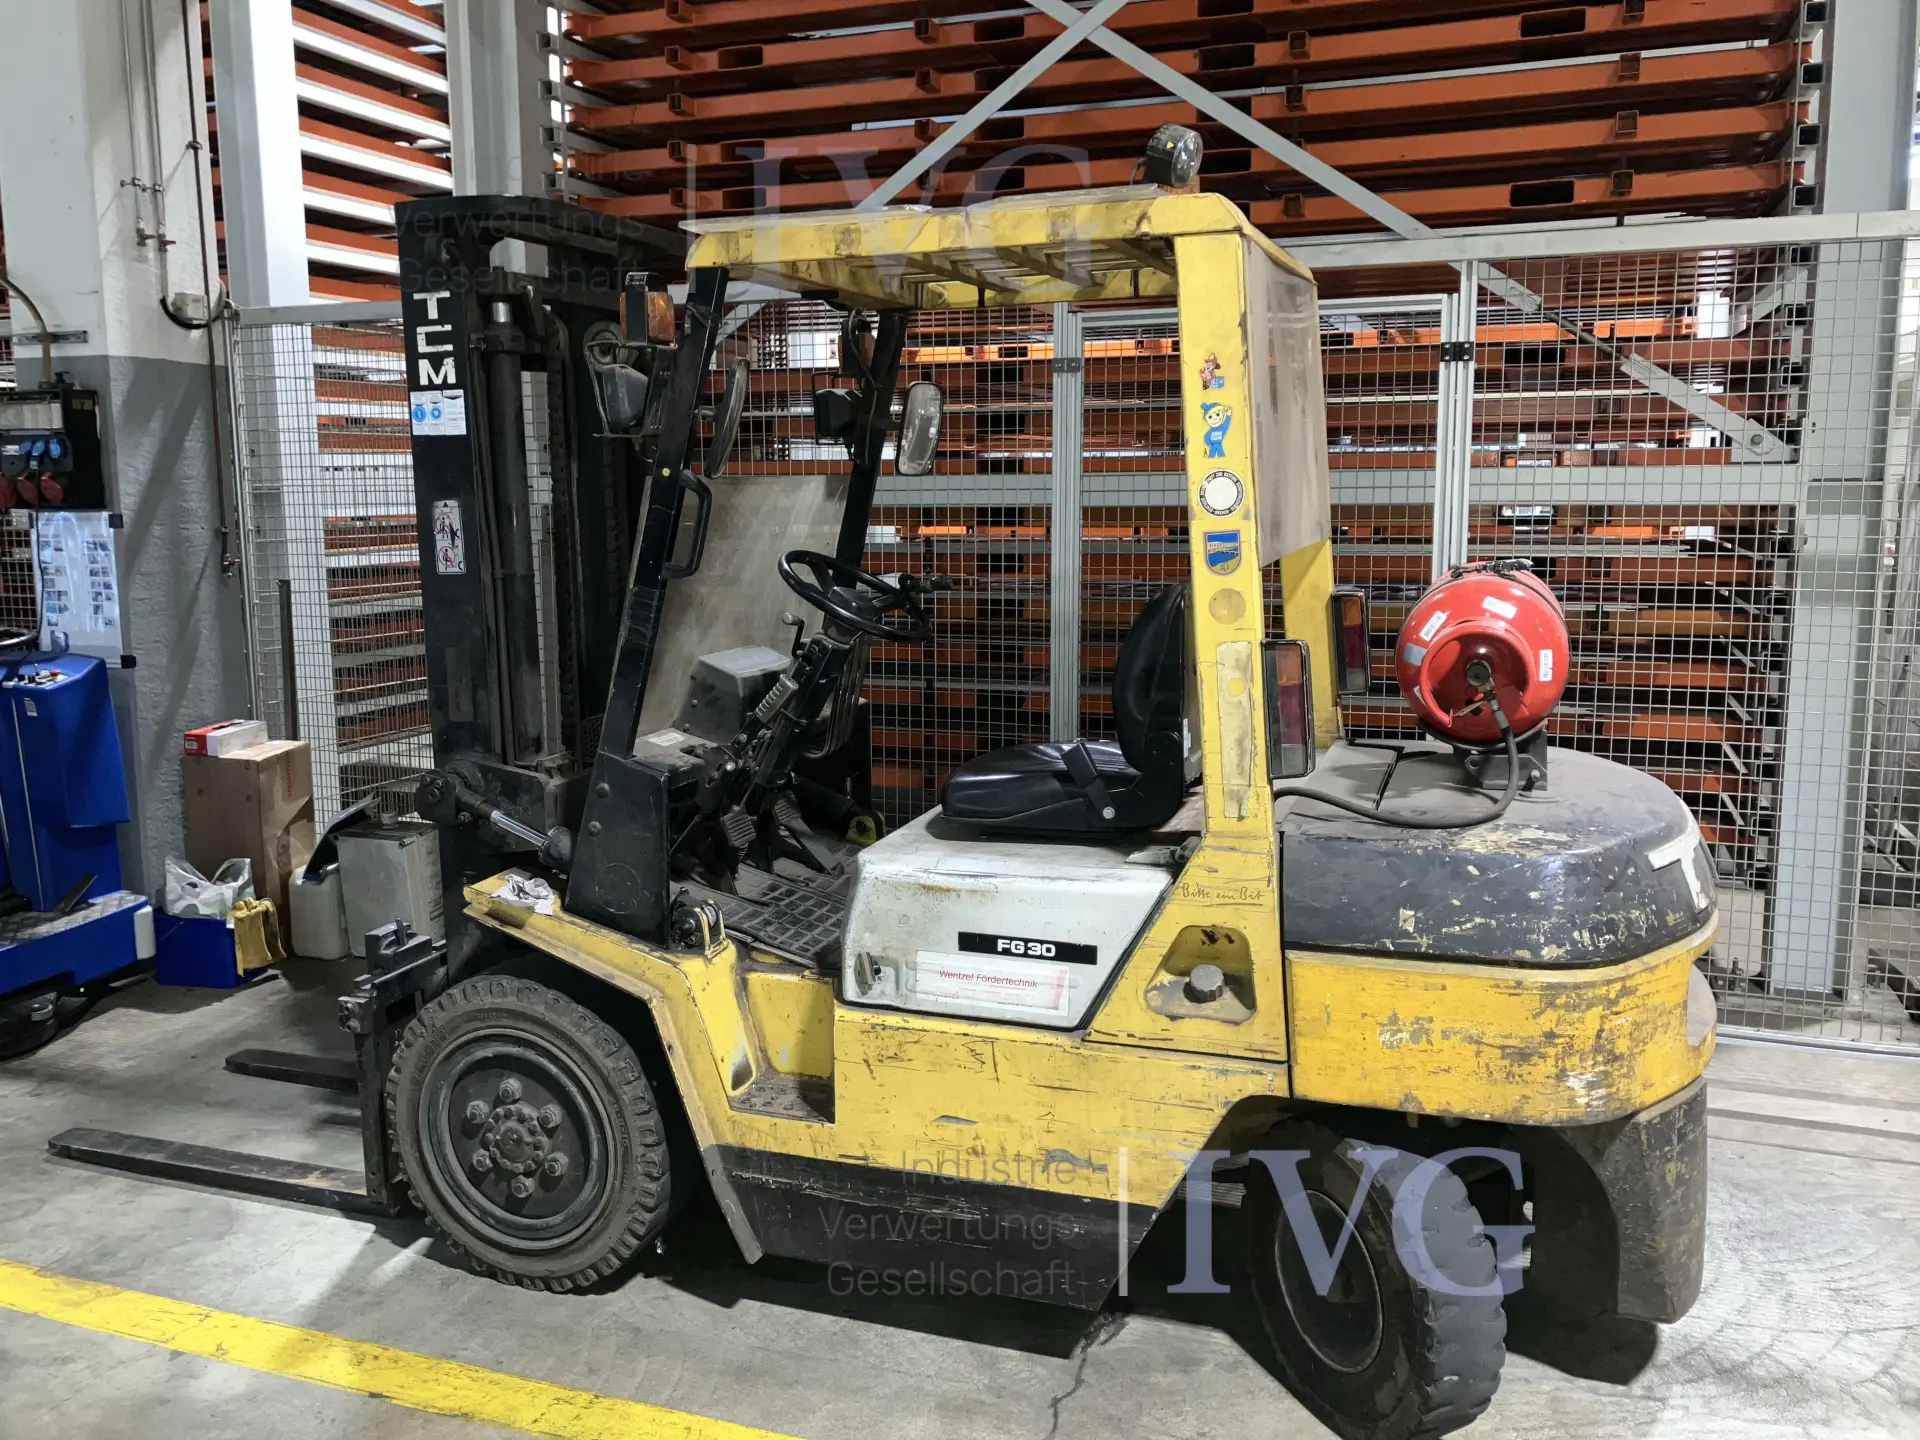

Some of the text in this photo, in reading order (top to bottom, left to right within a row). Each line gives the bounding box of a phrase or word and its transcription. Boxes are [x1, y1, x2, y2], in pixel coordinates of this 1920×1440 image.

[412, 290, 457, 387] TCM
[1182, 882, 1265, 900] Bitte ein Bit
[976, 973, 1039, 989] Fördertechnik
